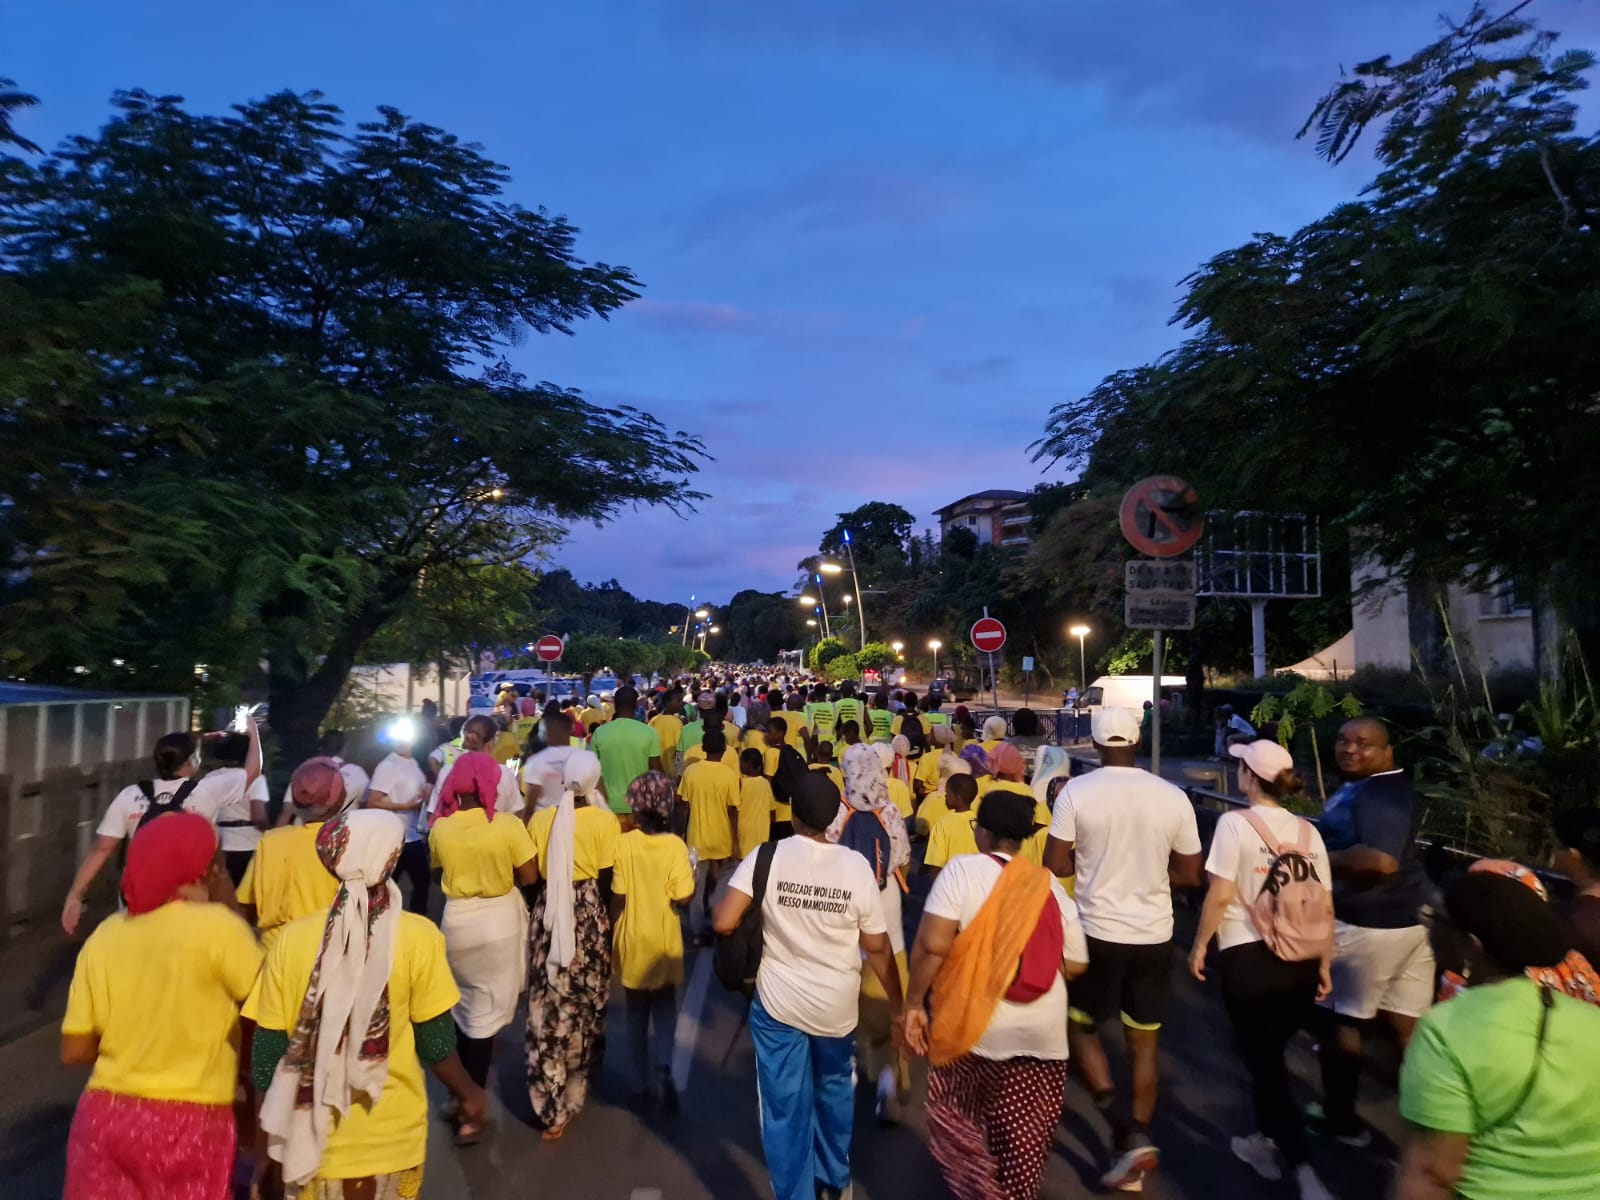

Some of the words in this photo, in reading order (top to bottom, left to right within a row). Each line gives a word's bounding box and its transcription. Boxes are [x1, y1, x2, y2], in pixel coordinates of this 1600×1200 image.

[842, 889, 852, 902] NA
[777, 895, 802, 908] MESSO
[802, 899, 848, 914] MAMOUDZOU
